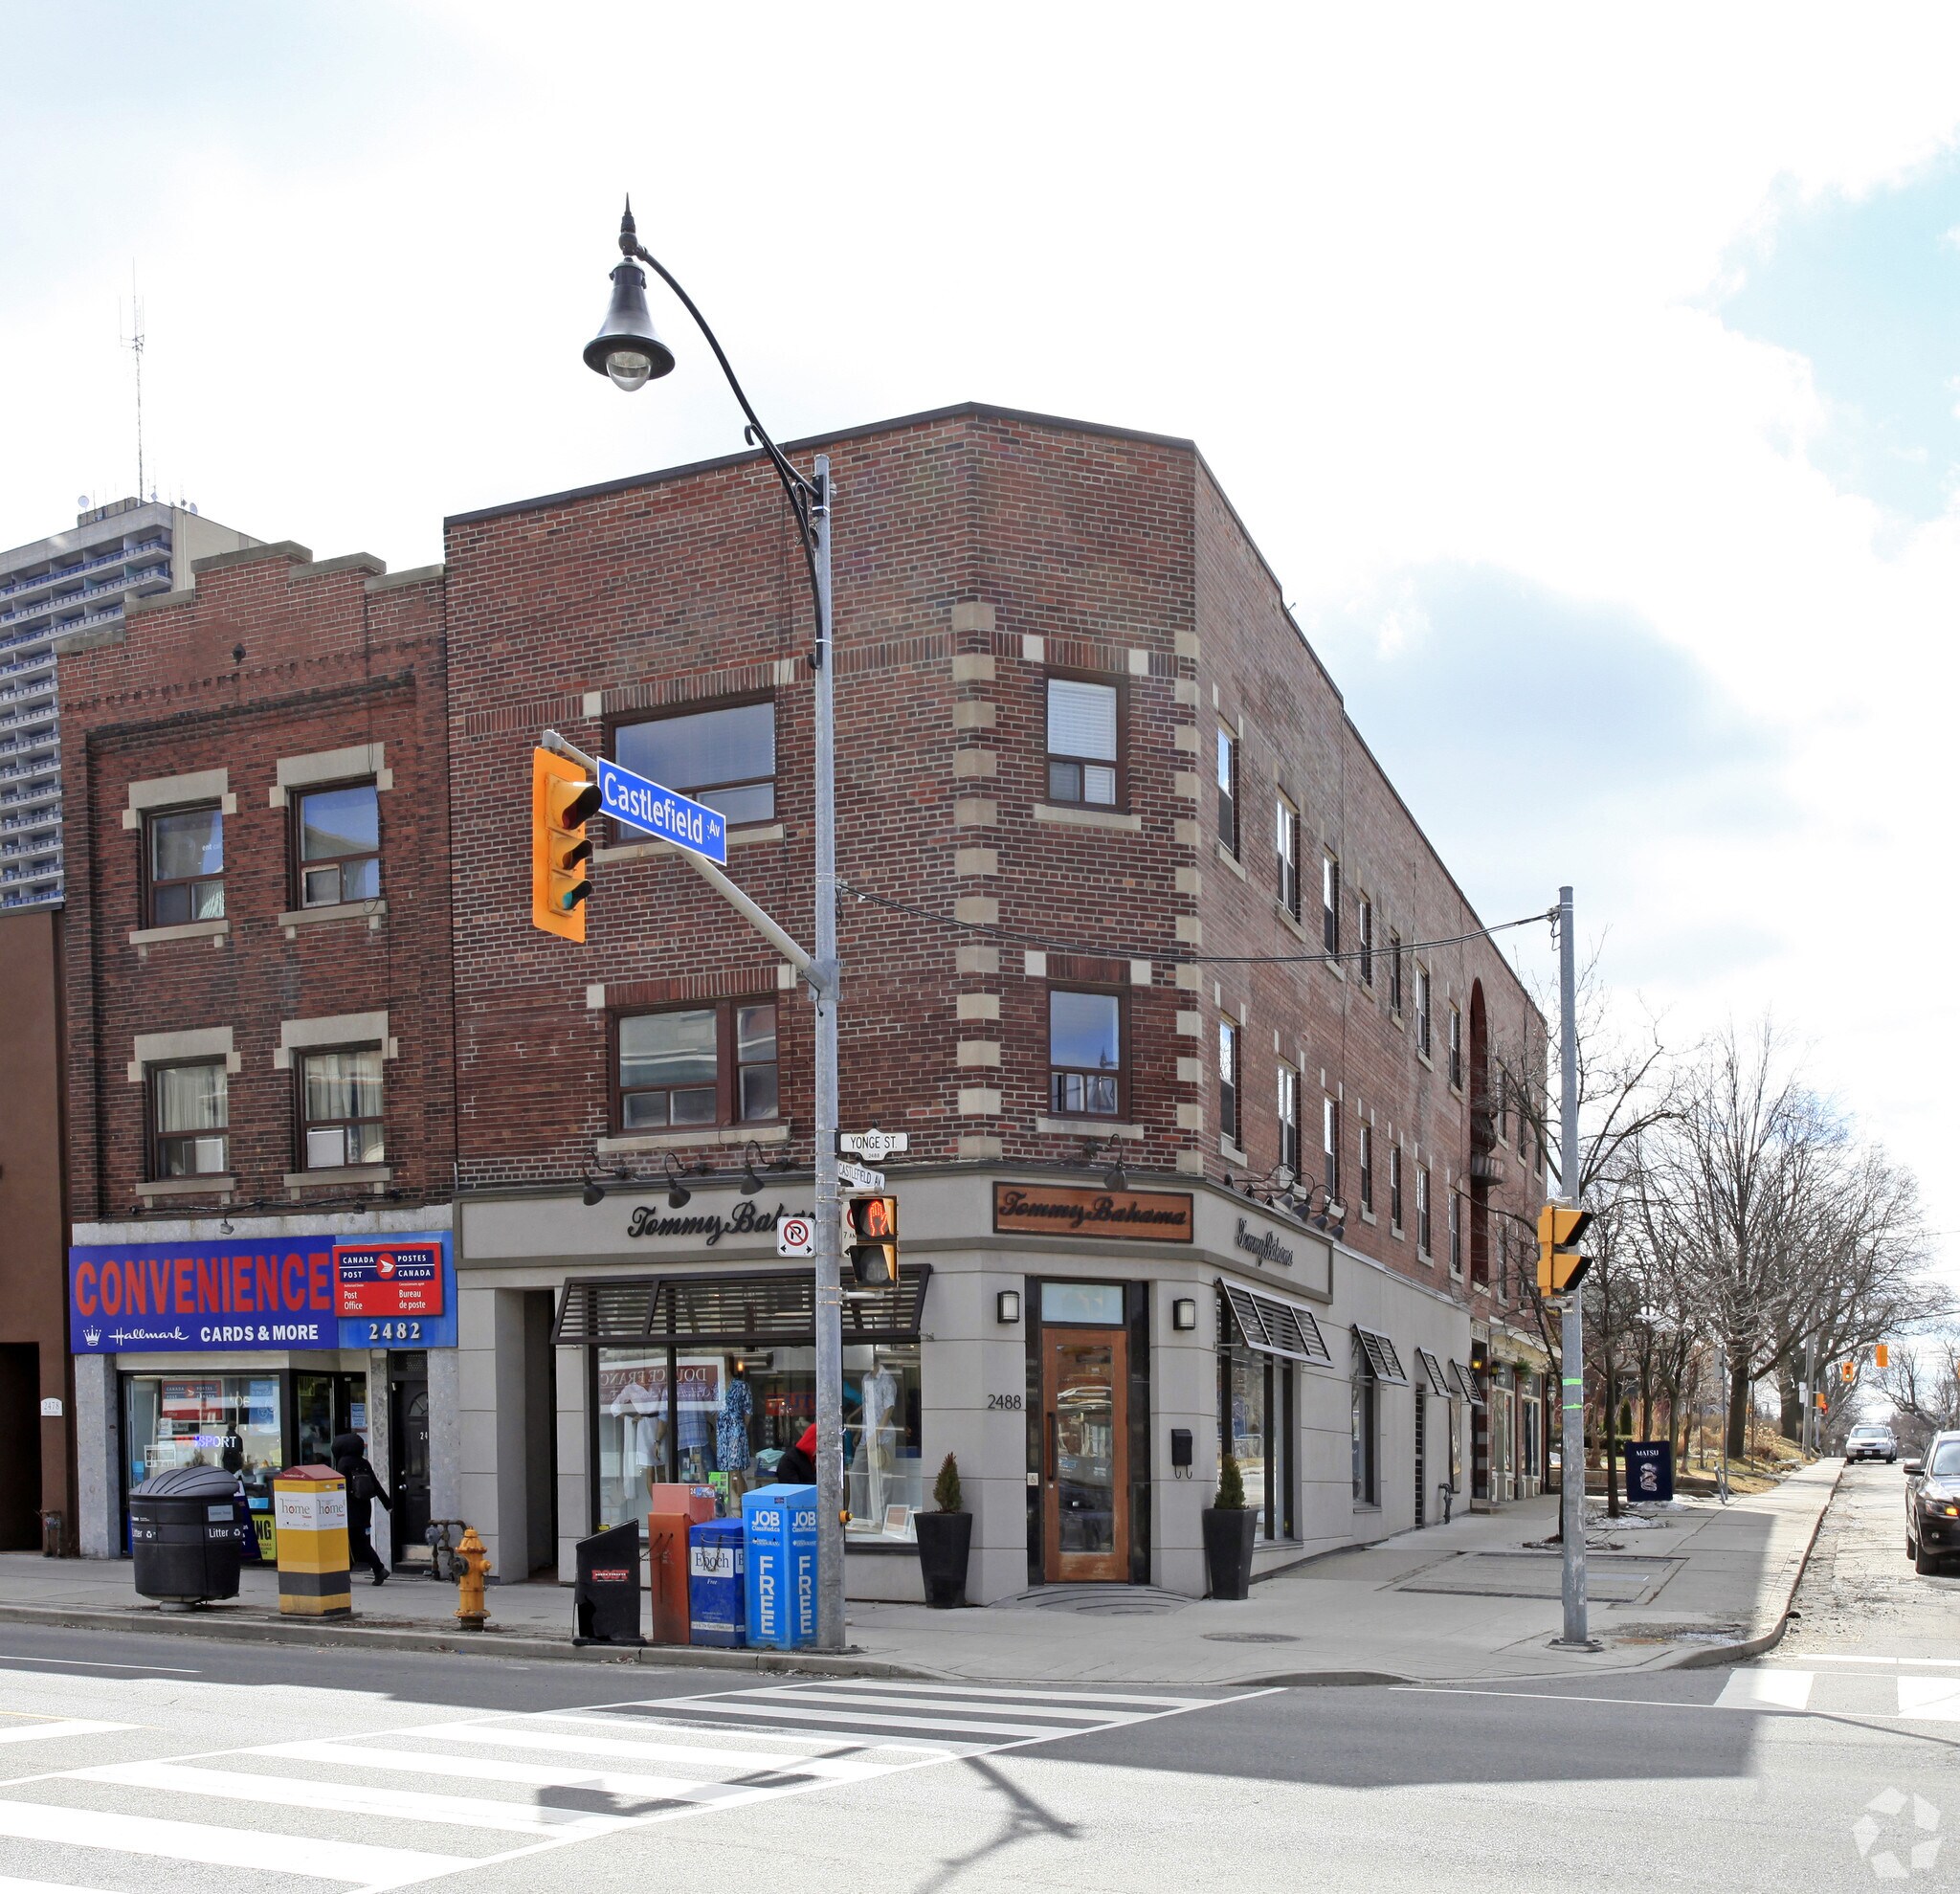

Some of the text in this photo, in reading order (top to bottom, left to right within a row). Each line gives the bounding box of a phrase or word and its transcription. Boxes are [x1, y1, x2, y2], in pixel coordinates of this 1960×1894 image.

[604, 771, 721, 845] Castlefield Av
[850, 1136, 880, 1149] YONGE
[838, 1163, 882, 1187] CASTLEFIELD AV
[999, 1191, 1187, 1229] Tommy Bahama
[627, 1205, 722, 1247] Tommy
[1236, 1217, 1293, 1267] Tommy Bahama
[343, 1256, 374, 1264] CANADA
[398, 1269, 431, 1278] CANADA
[76, 1253, 330, 1317] CONVENIENCE
[344, 1289, 422, 1300] Post Bureau
[344, 1301, 427, 1311] Office de poste
[108, 1324, 319, 1347] Hallmark CARDS & MORE
[368, 1322, 420, 1340] 2482
[987, 1393, 1022, 1409] 2488
[279, 1497, 311, 1515] home
[316, 1499, 344, 1515] home
[751, 1510, 780, 1526] JOB
[792, 1511, 816, 1527] JOB
[209, 1528, 229, 1538] Litter
[759, 1555, 775, 1635] FREE
[798, 1555, 813, 1635] FREE
